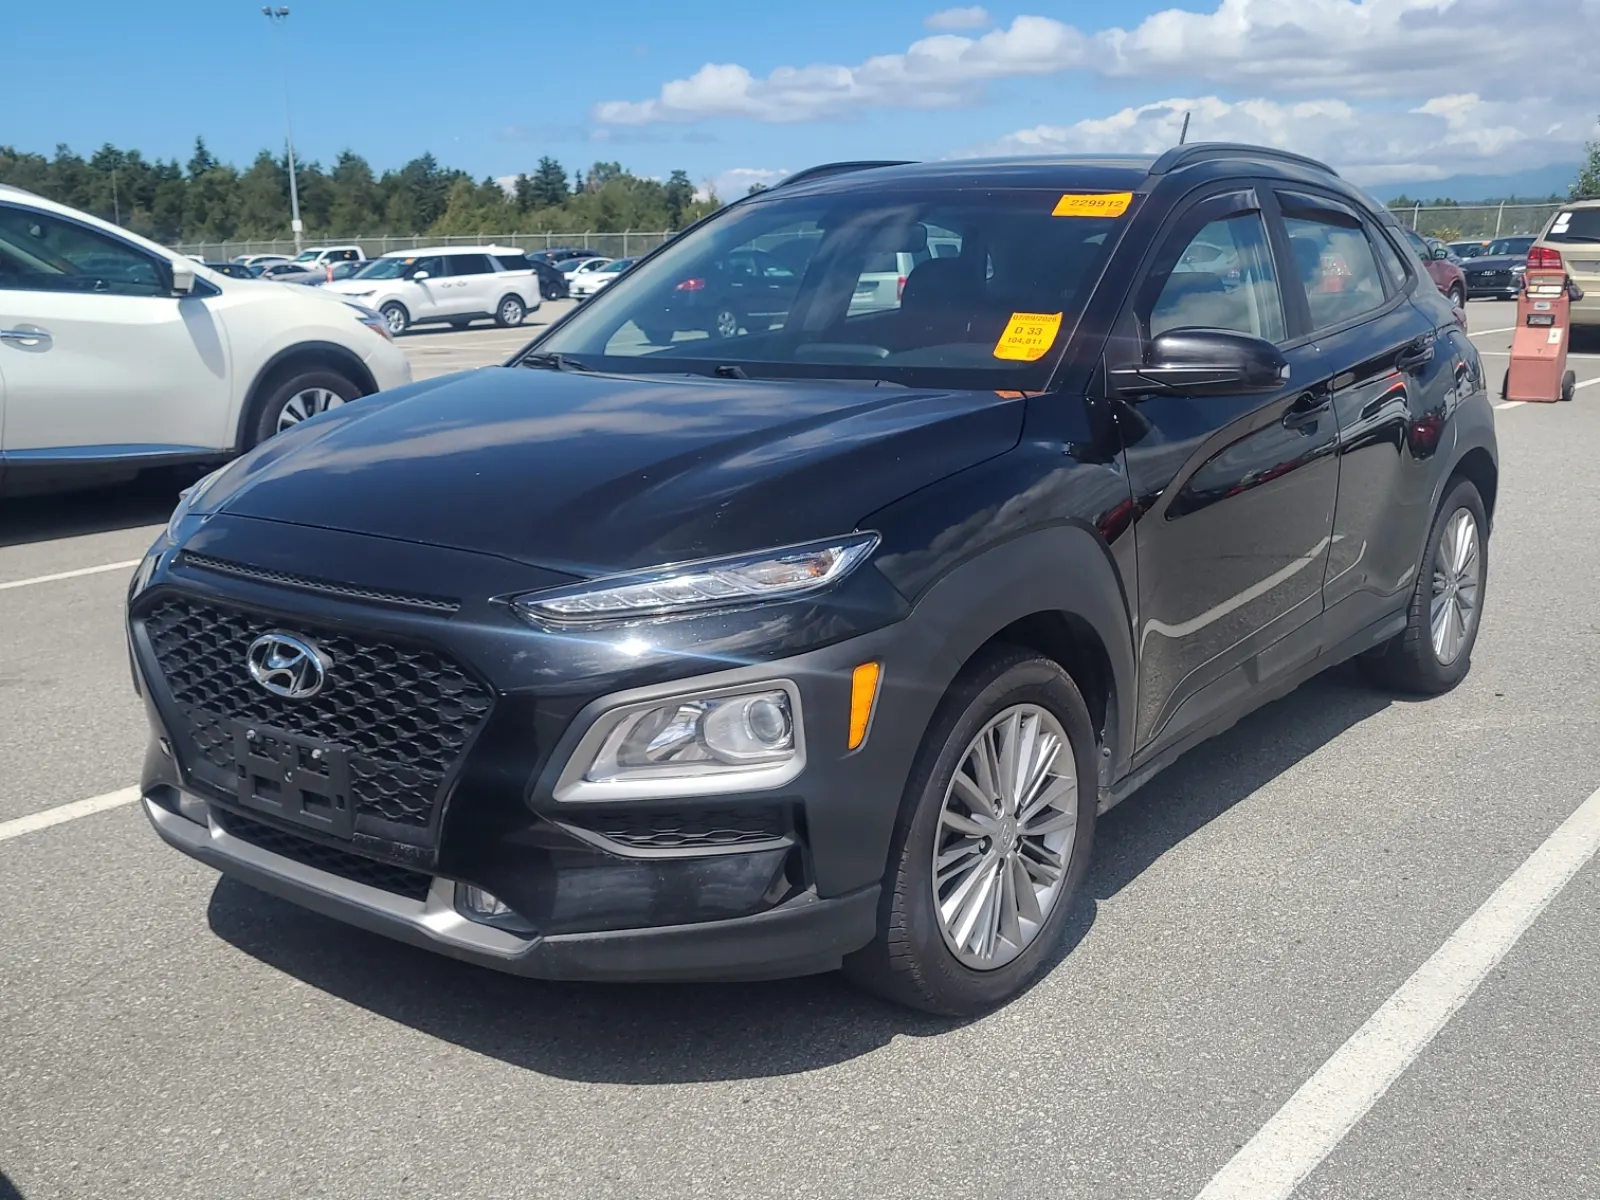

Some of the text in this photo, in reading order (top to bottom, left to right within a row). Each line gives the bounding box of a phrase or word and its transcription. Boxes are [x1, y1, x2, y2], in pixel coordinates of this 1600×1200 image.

[1070, 199, 1124, 208] 229912
[1014, 326, 1043, 336] D 33
